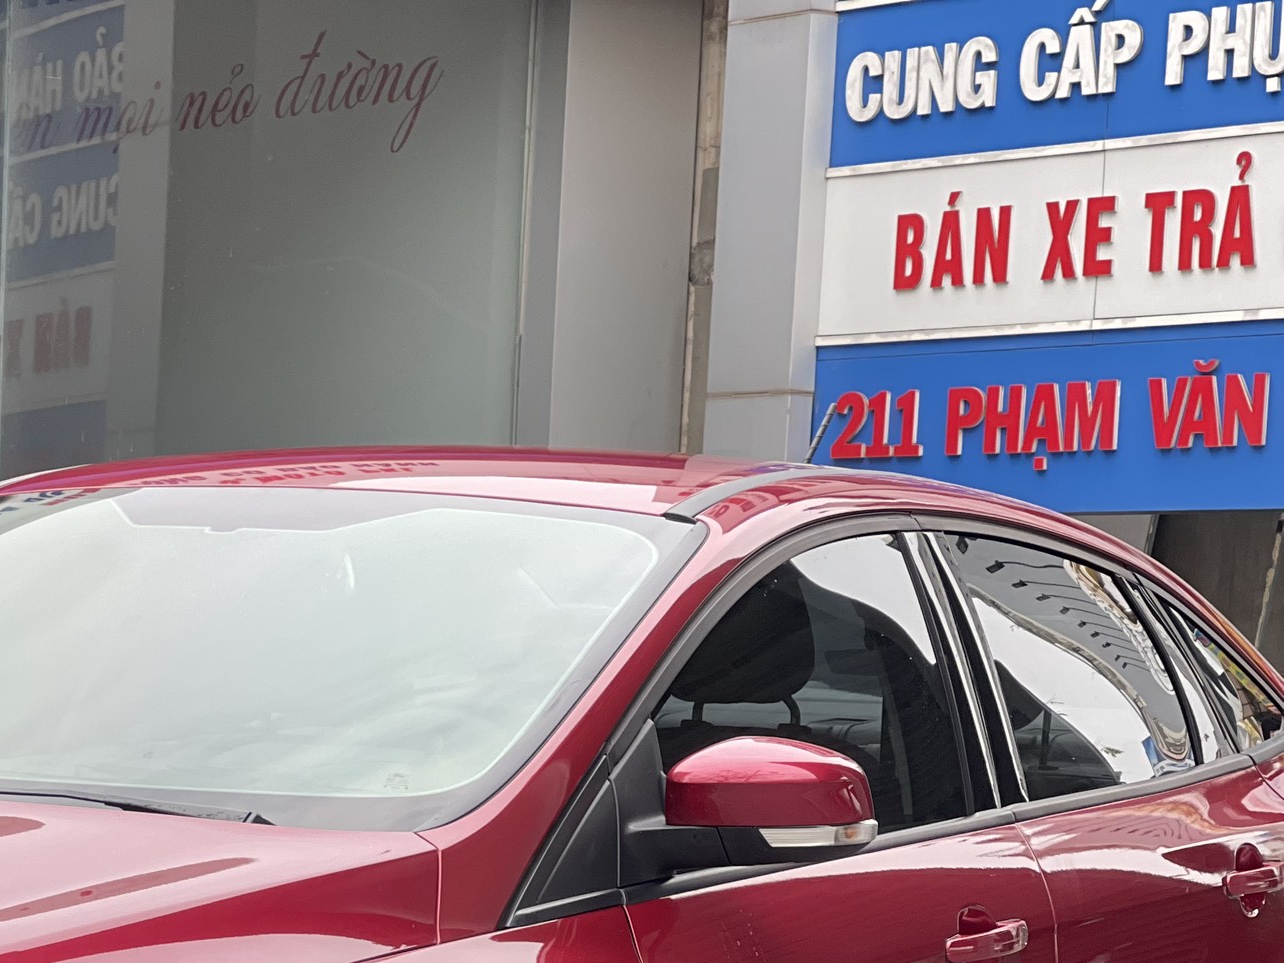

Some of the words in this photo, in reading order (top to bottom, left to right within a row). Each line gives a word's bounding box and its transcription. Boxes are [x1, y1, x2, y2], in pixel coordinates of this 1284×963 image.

[177, 63, 258, 132] nẻo
[274, 30, 443, 153] đường
[844, 36, 999, 123] CUNG
[1019, 0, 1144, 102] CẤP
[892, 191, 1014, 292] BÁN
[1040, 195, 1119, 282] XE
[1144, 151, 1257, 274] TRẢ
[830, 389, 924, 460] 211
[944, 378, 1122, 472] PHẠM
[1147, 359, 1271, 450] VĂN
